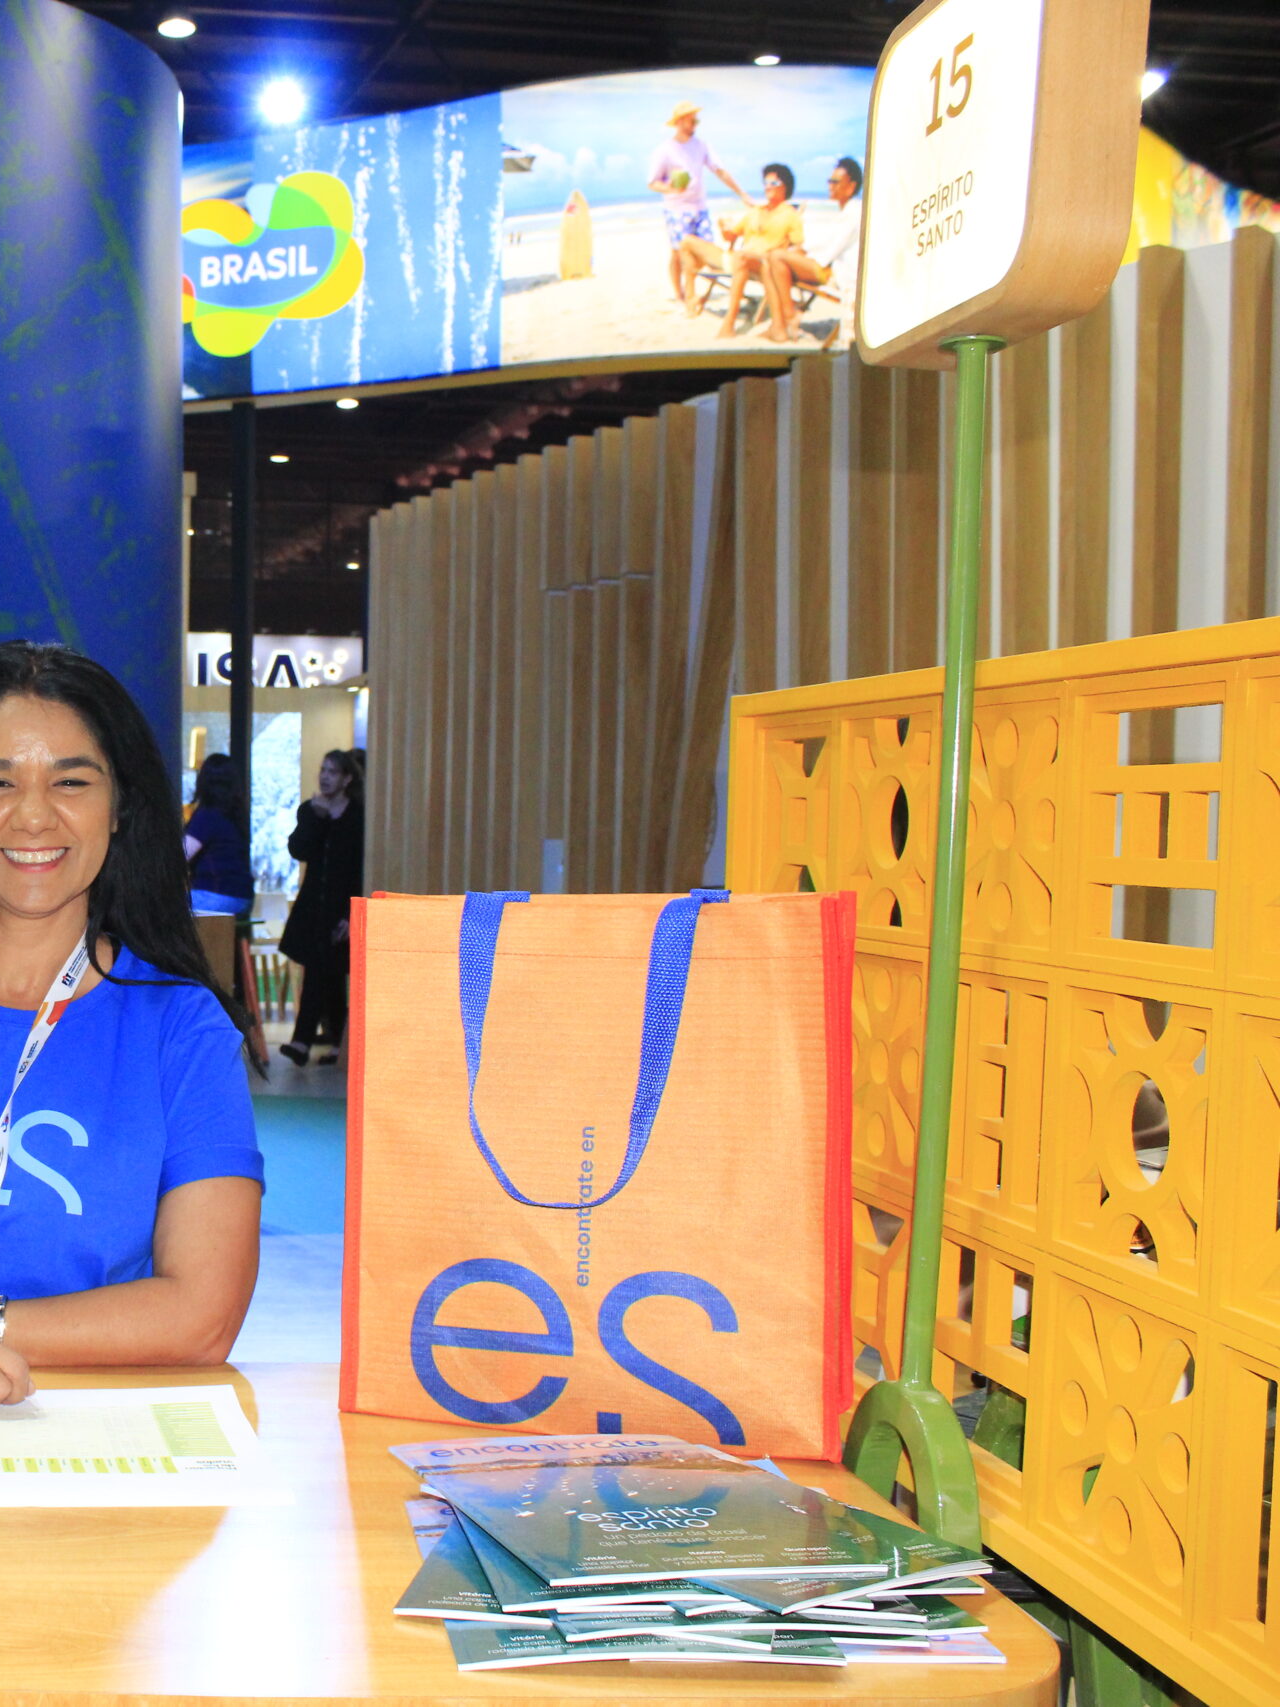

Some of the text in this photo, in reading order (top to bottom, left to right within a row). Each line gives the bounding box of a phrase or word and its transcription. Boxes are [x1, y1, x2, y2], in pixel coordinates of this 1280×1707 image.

[925, 32, 974, 137] 15
[912, 170, 973, 229] ESPÍRITO
[917, 209, 963, 257] SANTO
[200, 244, 318, 288] BRASIL
[576, 1125, 596, 1288] encontrate en
[429, 1438, 661, 1458] encontrate
[598, 1518, 710, 1532] santo
[599, 1539, 629, 1548] que
[677, 1535, 706, 1545] que
[627, 1529, 684, 1539] pedazo
[685, 1528, 705, 1536] de
[706, 1527, 747, 1536] Brasil
